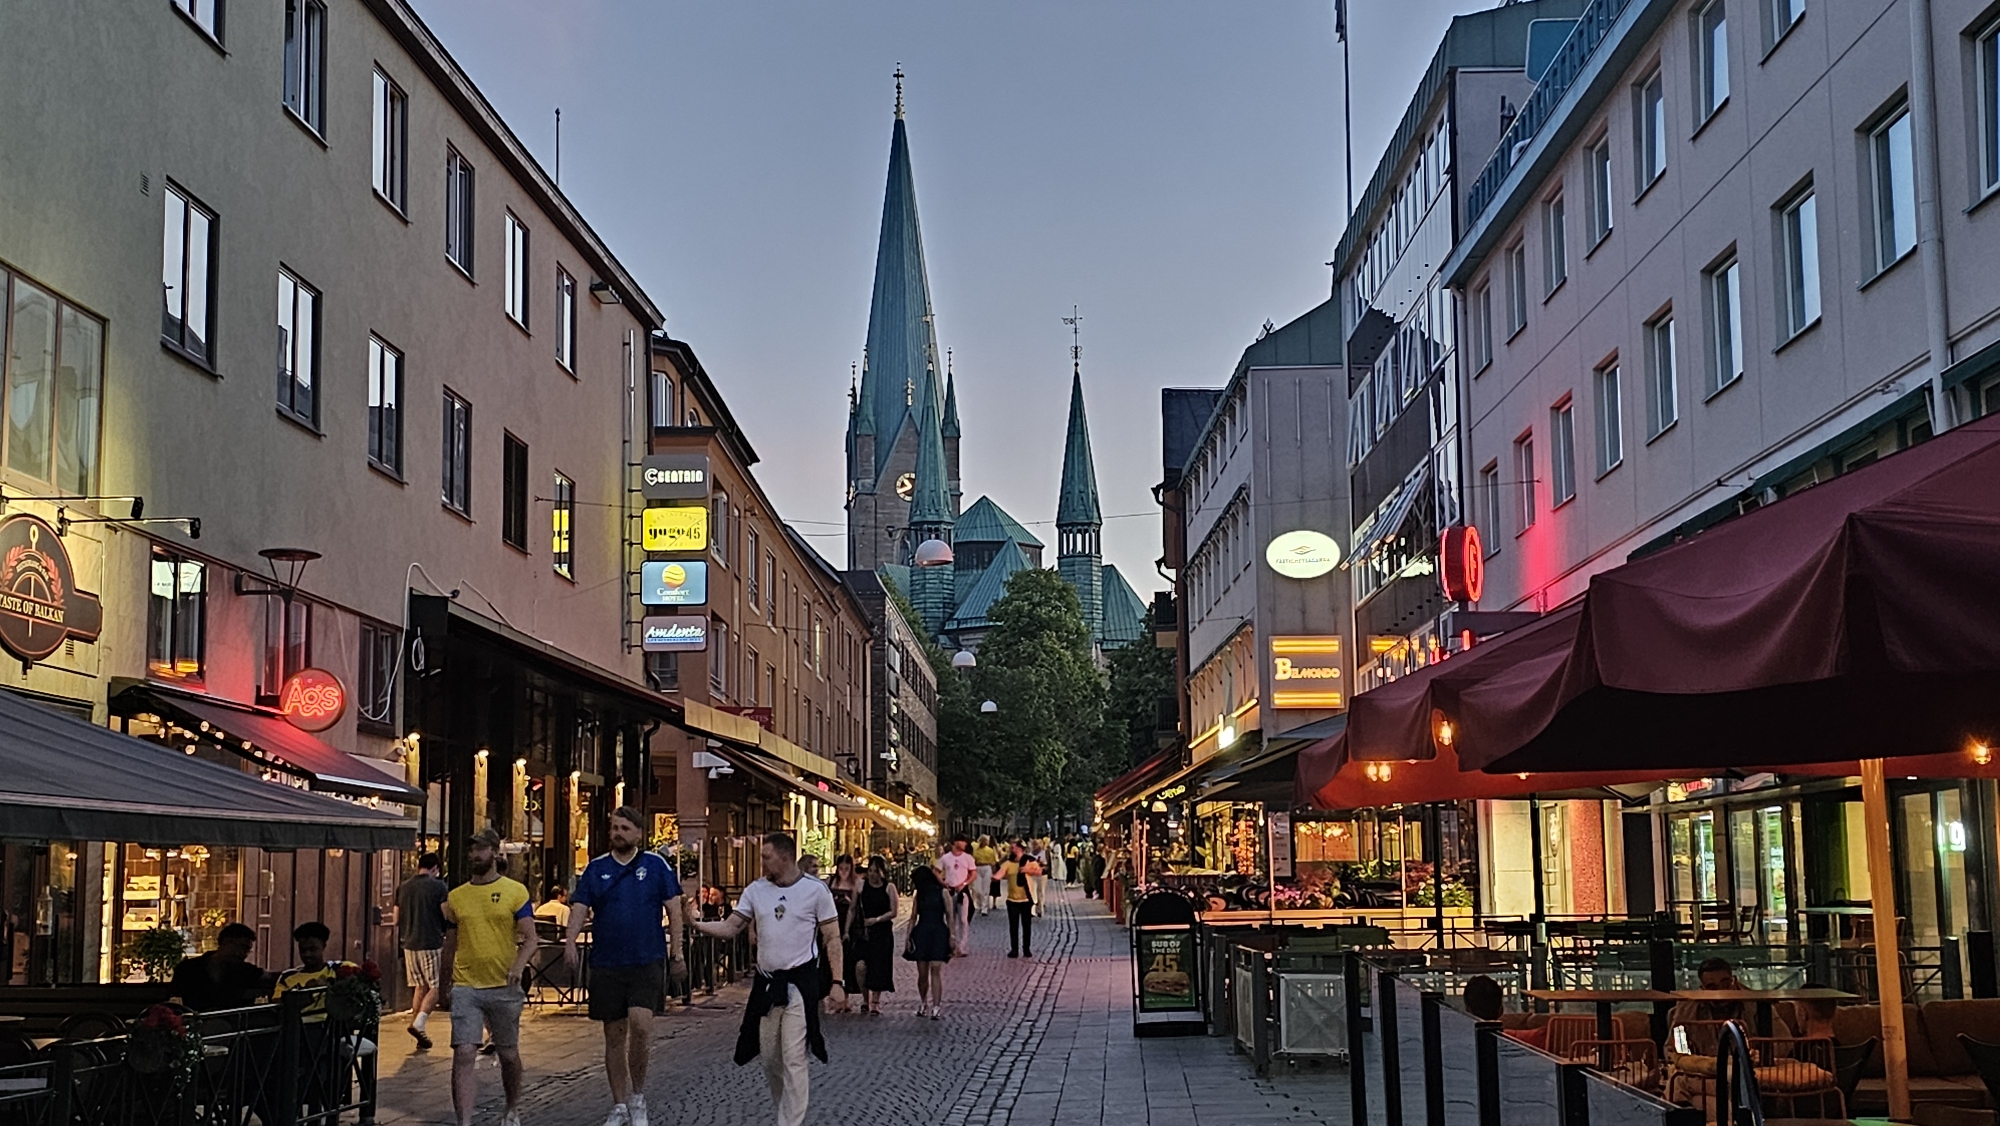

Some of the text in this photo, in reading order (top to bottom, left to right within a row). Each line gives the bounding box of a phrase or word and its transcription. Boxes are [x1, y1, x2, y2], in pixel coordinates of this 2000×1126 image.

[656, 587, 690, 596] Comfort
[23, 600, 34, 615] OF
[35, 604, 64, 623] BALKAN
[1274, 657, 1340, 680] BELMONDO
[1151, 940, 1168, 948] SUB
[1149, 954, 1178, 972] 45
